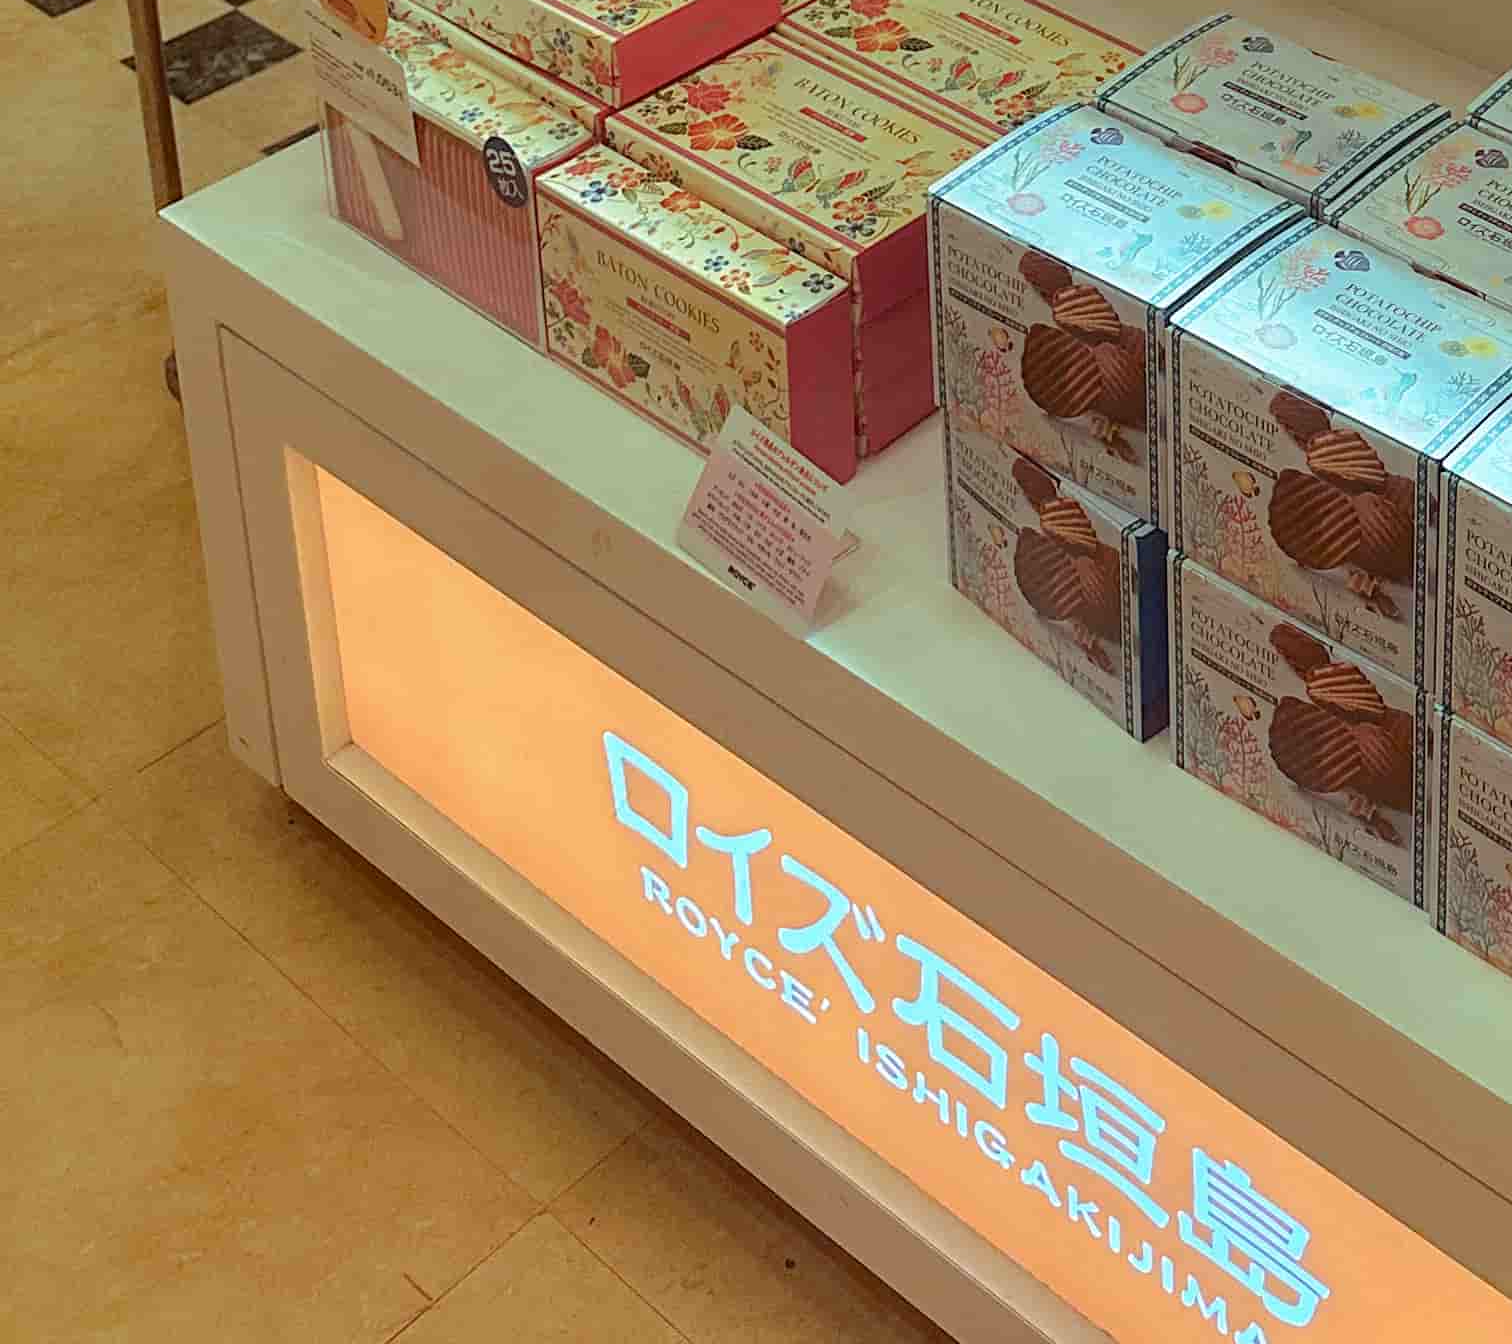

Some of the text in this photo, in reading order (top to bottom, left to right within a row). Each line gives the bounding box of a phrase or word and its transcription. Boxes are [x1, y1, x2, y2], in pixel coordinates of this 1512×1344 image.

[1001, 10, 1073, 49] COOKIES
[794, 75, 923, 146] BATON COOKIES
[486, 148, 516, 176] 25
[1085, 164, 1169, 207] CHOCOLATE
[596, 250, 721, 334] BATON COOKIES
[1335, 293, 1427, 344] CHOCOLATE
[1344, 281, 1441, 332] POTATOCHIP
[1189, 381, 1280, 436] POTATOCHIP
[1189, 398, 1276, 452] CHOCOLATE
[1190, 607, 1279, 664] POTATOCHIP
[1190, 623, 1275, 682] CHOCOLATE
[603, 731, 1331, 1327] ロイズ石垣島
[856, 1027, 1272, 1344] ISHIGAKIJIMA
